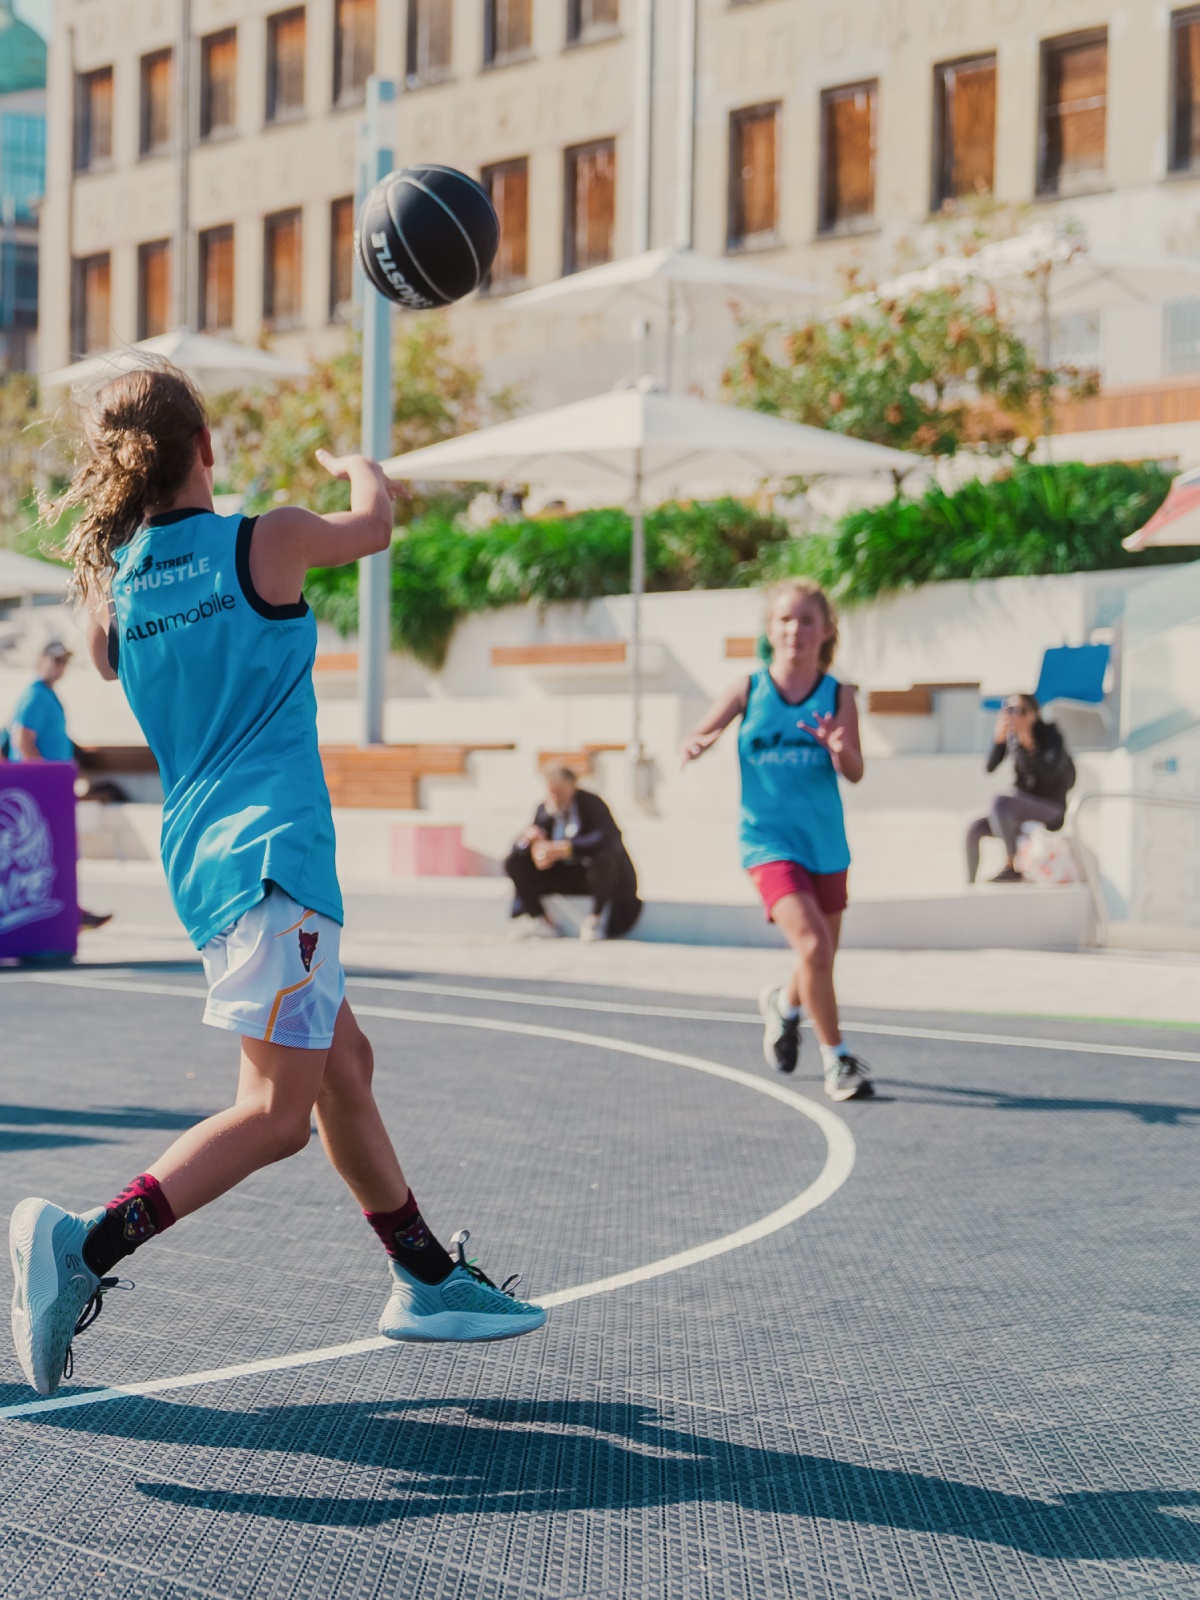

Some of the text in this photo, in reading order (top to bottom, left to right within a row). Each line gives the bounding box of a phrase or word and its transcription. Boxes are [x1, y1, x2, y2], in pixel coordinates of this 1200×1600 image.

[133, 556, 211, 593] HUSTLE
[155, 552, 194, 570] STREET
[125, 591, 236, 643] ALDImobile
